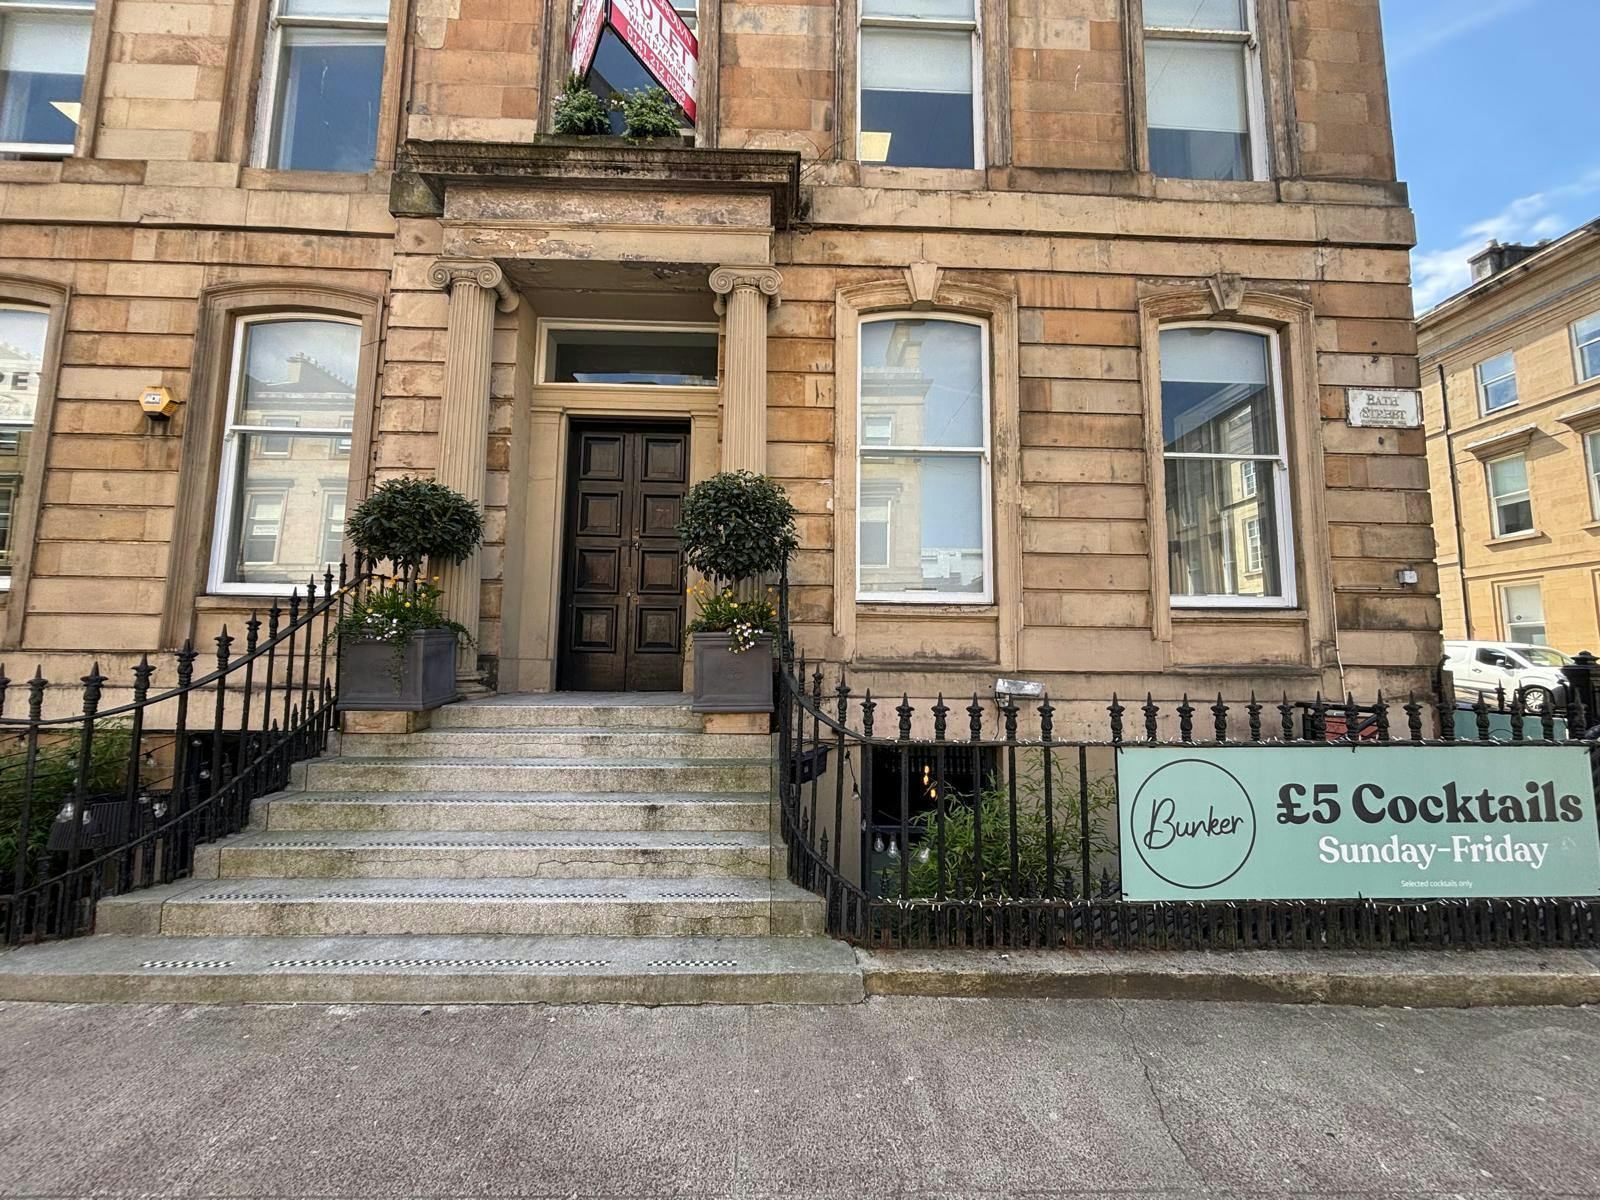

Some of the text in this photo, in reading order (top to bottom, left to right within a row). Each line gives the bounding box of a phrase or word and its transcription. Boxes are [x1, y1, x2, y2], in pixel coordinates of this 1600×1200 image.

[626, 24, 647, 56] 0141
[649, 52, 665, 78] 212
[629, 10, 686, 88] WITH PARKING
[642, 14, 652, 34] TO
[687, 72, 696, 87] FT
[659, 14, 689, 65] LET
[1360, 407, 1407, 419] STREET
[1366, 394, 1400, 406] BATH
[1143, 798, 1244, 850] Bunker
[1276, 781, 1583, 824] £5 Cocktails
[1400, 880, 1473, 889] Selected cocktails only
